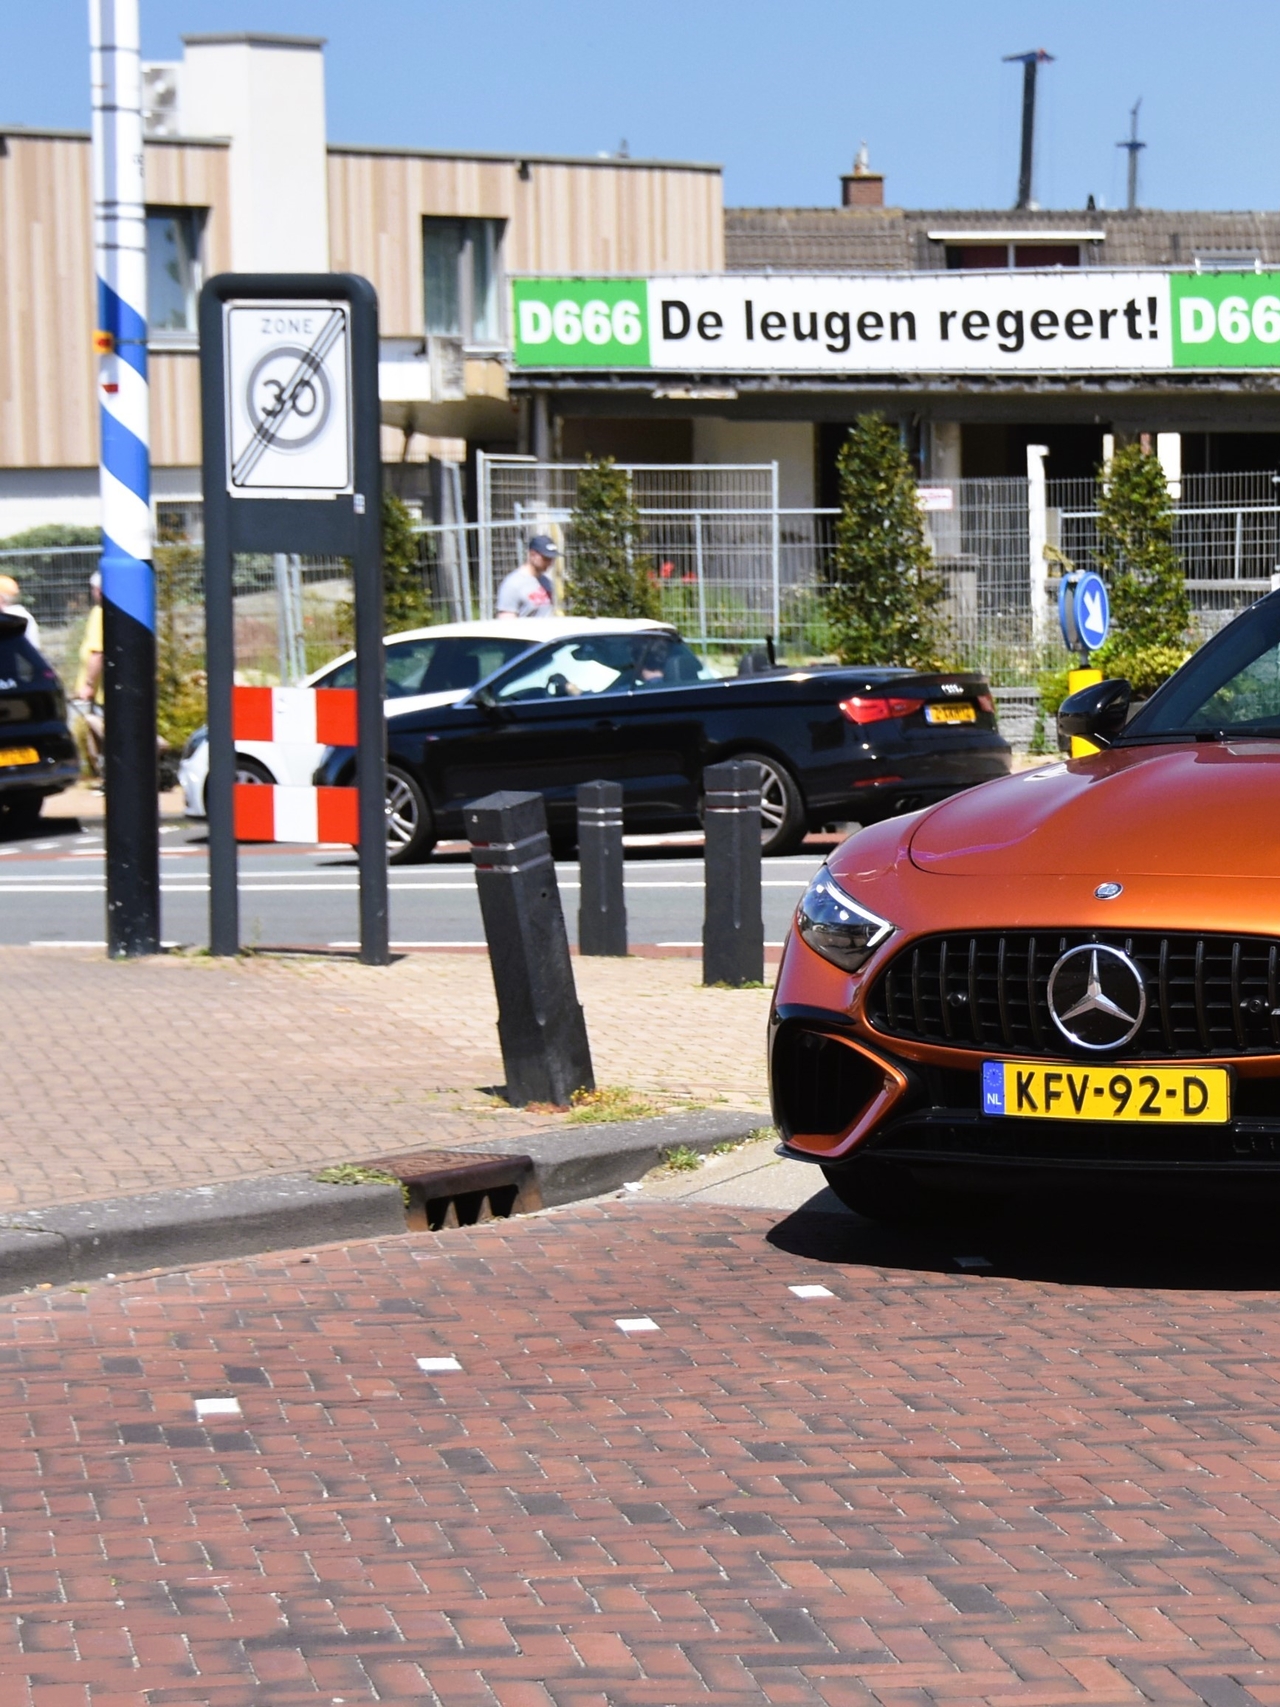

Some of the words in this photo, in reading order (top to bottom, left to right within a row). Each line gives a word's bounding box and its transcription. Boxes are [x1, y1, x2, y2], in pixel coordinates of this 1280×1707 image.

[261, 317, 314, 335] ZONE
[518, 299, 643, 346] D666
[661, 300, 724, 341] De
[745, 300, 917, 353] leugen
[939, 296, 1158, 353] regeert!
[261, 378, 317, 417] 30
[987, 1092, 1002, 1105] NL
[1016, 1070, 1209, 1115] KFV-92-D
